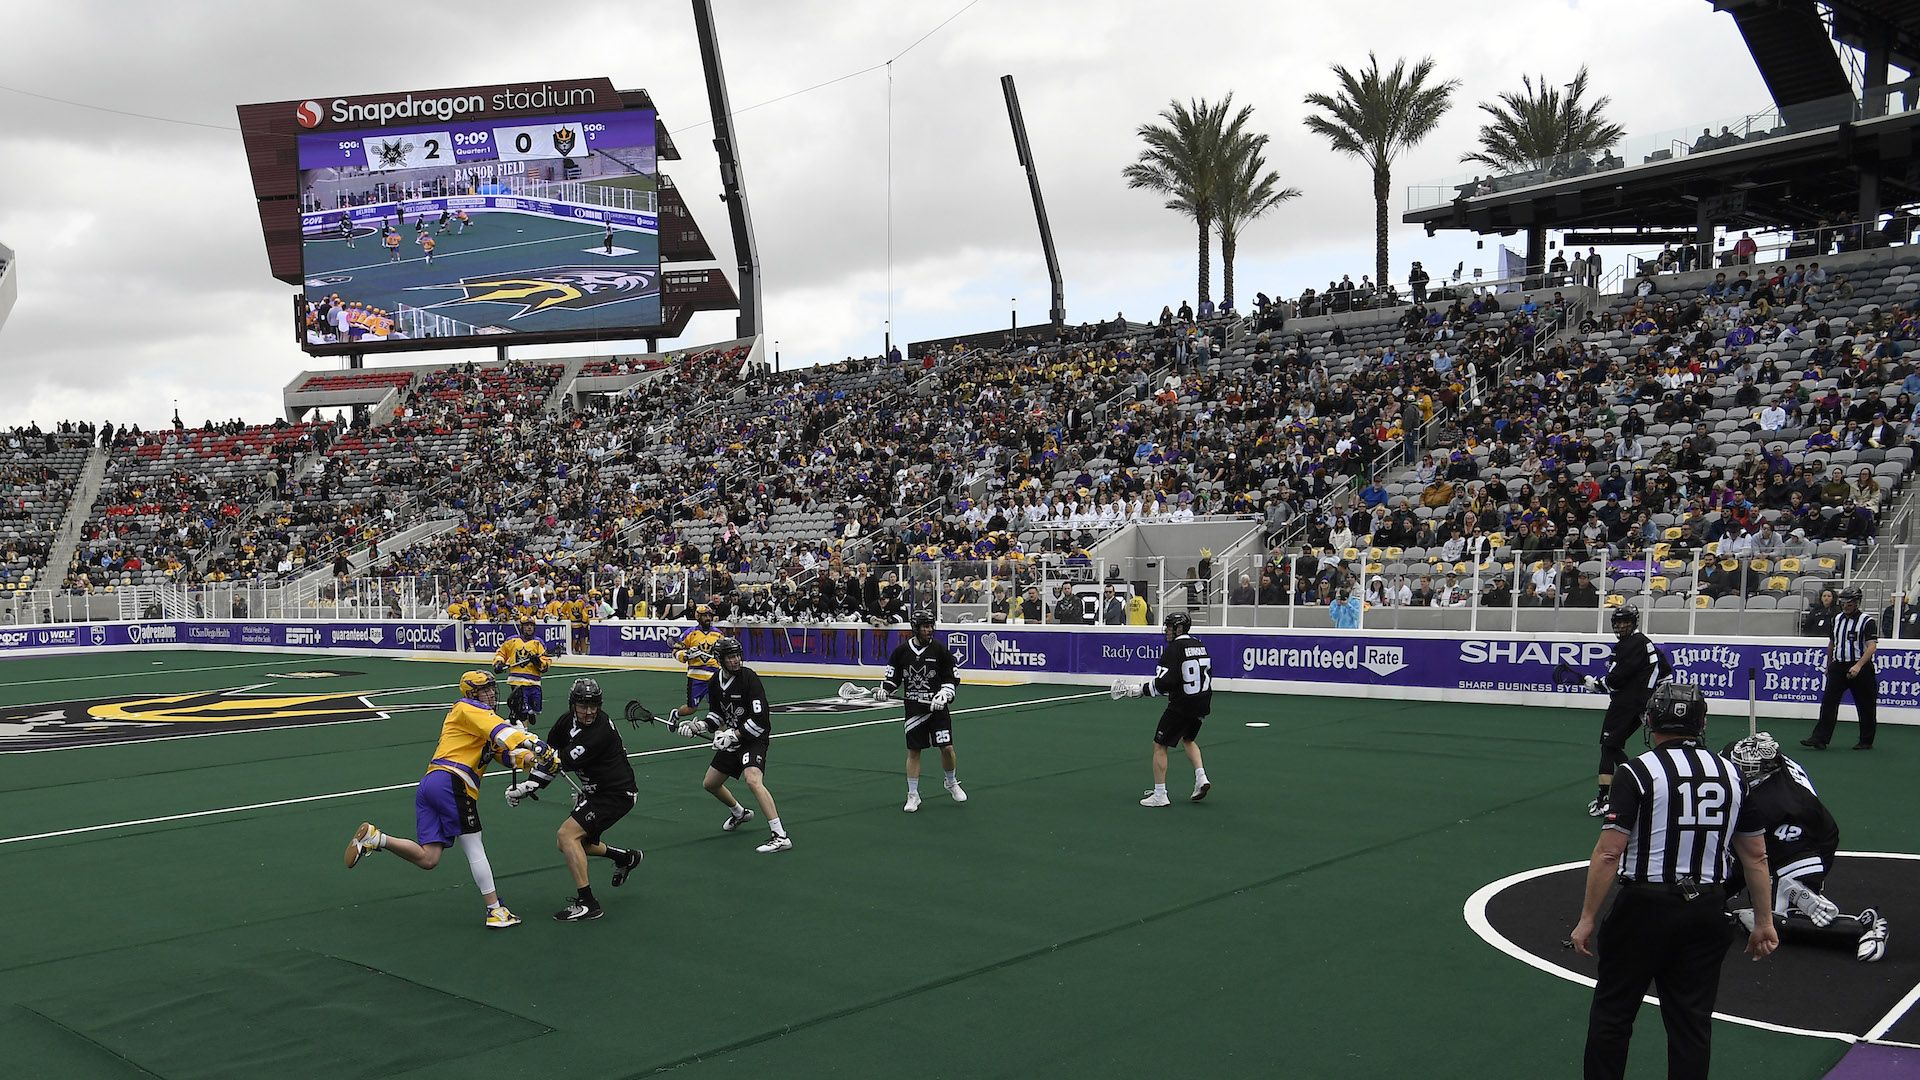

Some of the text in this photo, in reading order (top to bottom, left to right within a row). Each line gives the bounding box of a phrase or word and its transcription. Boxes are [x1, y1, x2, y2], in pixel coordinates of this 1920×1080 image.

[331, 83, 595, 125] Snapdragon stadium
[584, 123, 606, 132] SOG:
[454, 131, 489, 146] 9:09
[515, 132, 532, 153] 0
[589, 132, 596, 141] 3
[338, 141, 360, 150] SOG:
[424, 139, 440, 160] 2
[344, 150, 351, 158] 3
[455, 161, 525, 182] BASHOR FIELD
[0, 632, 28, 642] OCH
[50, 630, 75, 639] WOLF
[141, 624, 176, 640] adrenaline
[332, 628, 369, 643] guaranteed
[475, 625, 505, 647] arté
[620, 626, 681, 641] SHARP
[950, 634, 966, 644] NLL
[995, 639, 1021, 652] NLL
[1102, 645, 1133, 661] Rady
[1459, 640, 1613, 666] SHARP
[660, 652, 672, 660] SYST
[995, 651, 1047, 666] UNITES
[1242, 644, 1400, 671] guaranteed Rate
[1671, 645, 1741, 669] Knotty
[1181, 657, 1211, 695] 97
[1675, 669, 1735, 688] Barrel
[1763, 672, 1827, 691] Barrel
[1458, 680, 1591, 693] SHARP BUSINESS SYST
[1772, 693, 1818, 701] gastropub
[1876, 698, 1918, 706] astropub
[752, 699, 762, 714] 6
[935, 730, 950, 744] 25
[742, 752, 750, 766] 6
[1677, 782, 1726, 826] 12
[1774, 823, 1803, 842] 42
